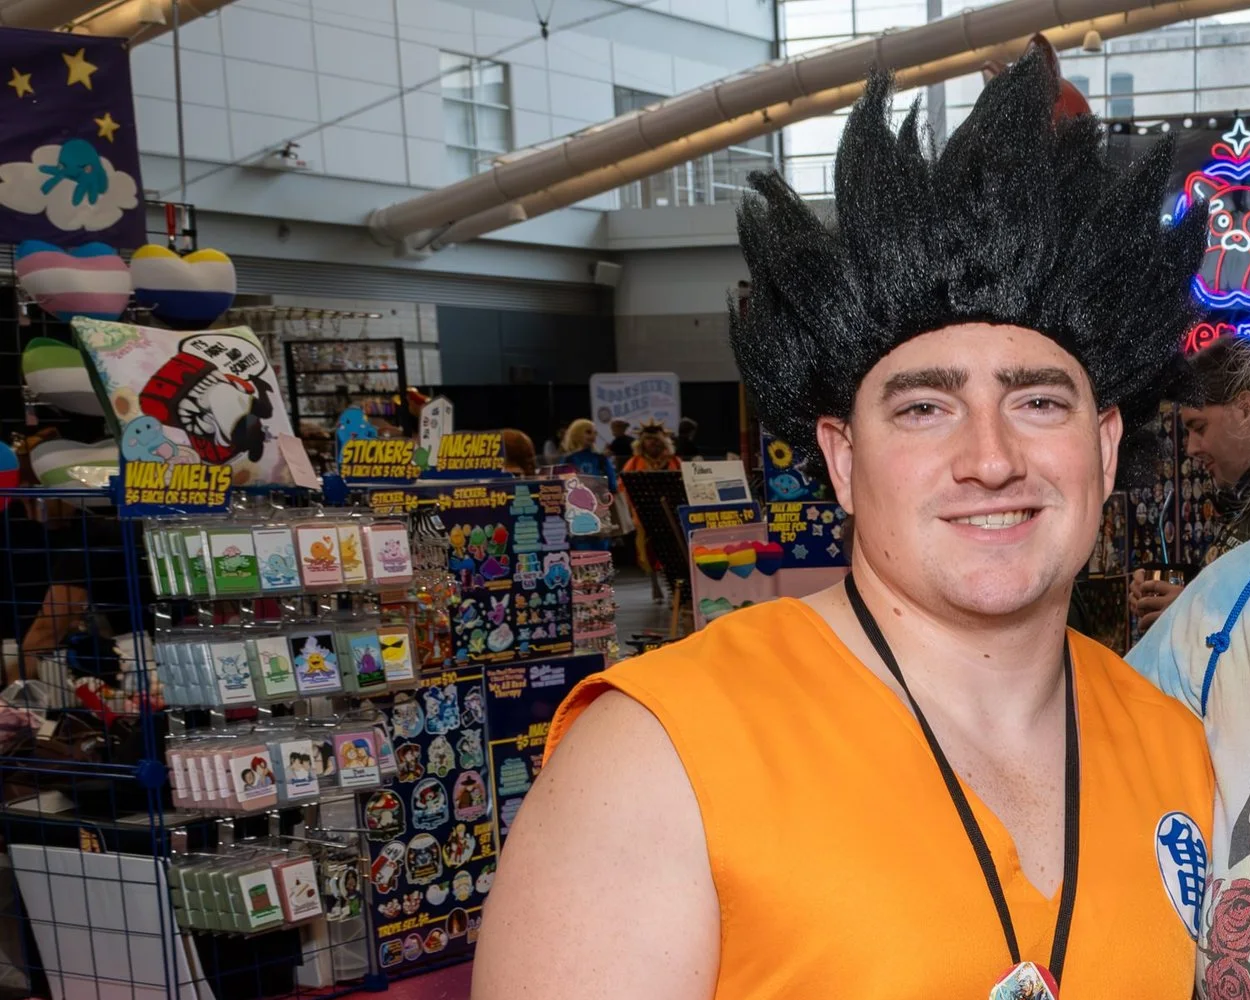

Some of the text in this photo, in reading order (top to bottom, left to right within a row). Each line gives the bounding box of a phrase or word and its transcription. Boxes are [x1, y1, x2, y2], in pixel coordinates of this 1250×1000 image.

[341, 439, 415, 465] STICKERS
[438, 433, 501, 458] MAGNETS
[126, 461, 232, 492] WAX MELTS
